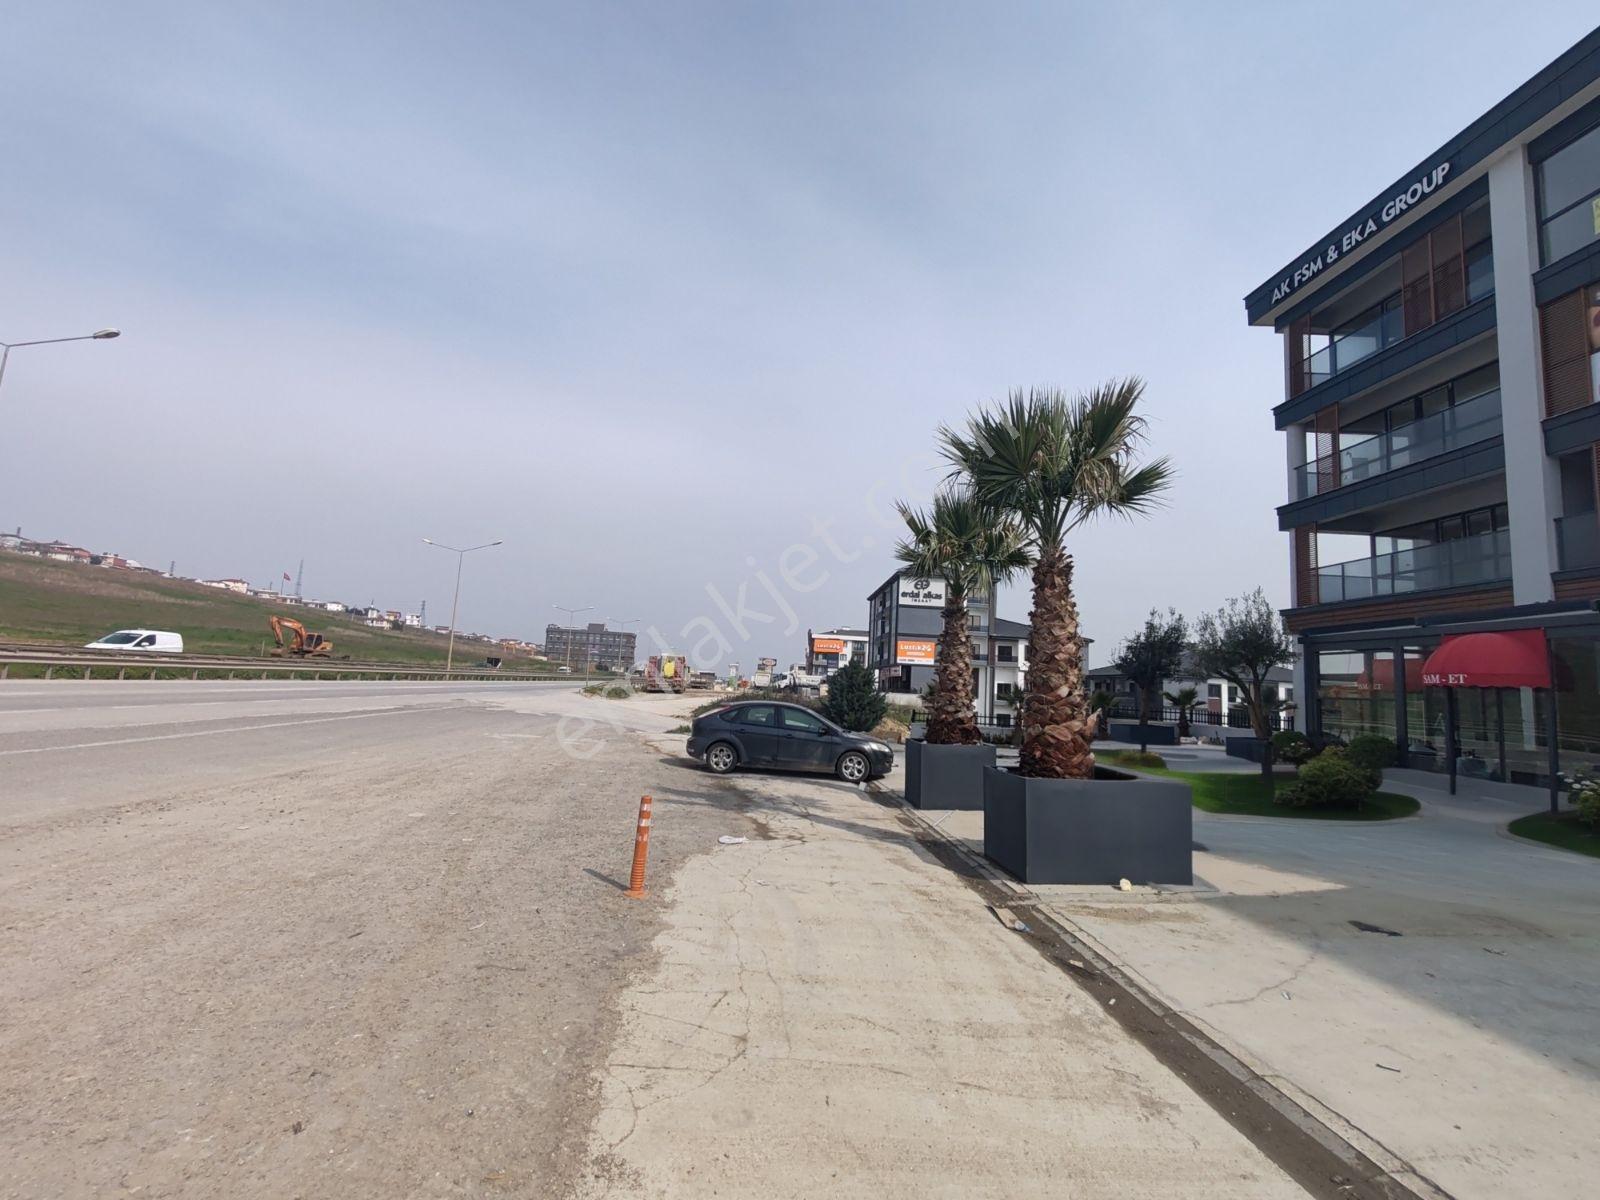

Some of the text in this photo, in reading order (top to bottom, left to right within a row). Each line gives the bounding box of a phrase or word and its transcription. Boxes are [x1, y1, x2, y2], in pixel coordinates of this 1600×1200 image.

[1271, 162, 1450, 304] AK FSM & EKA GROUP
[1423, 673, 1440, 684] SAM
[1448, 673, 1468, 684] ET
